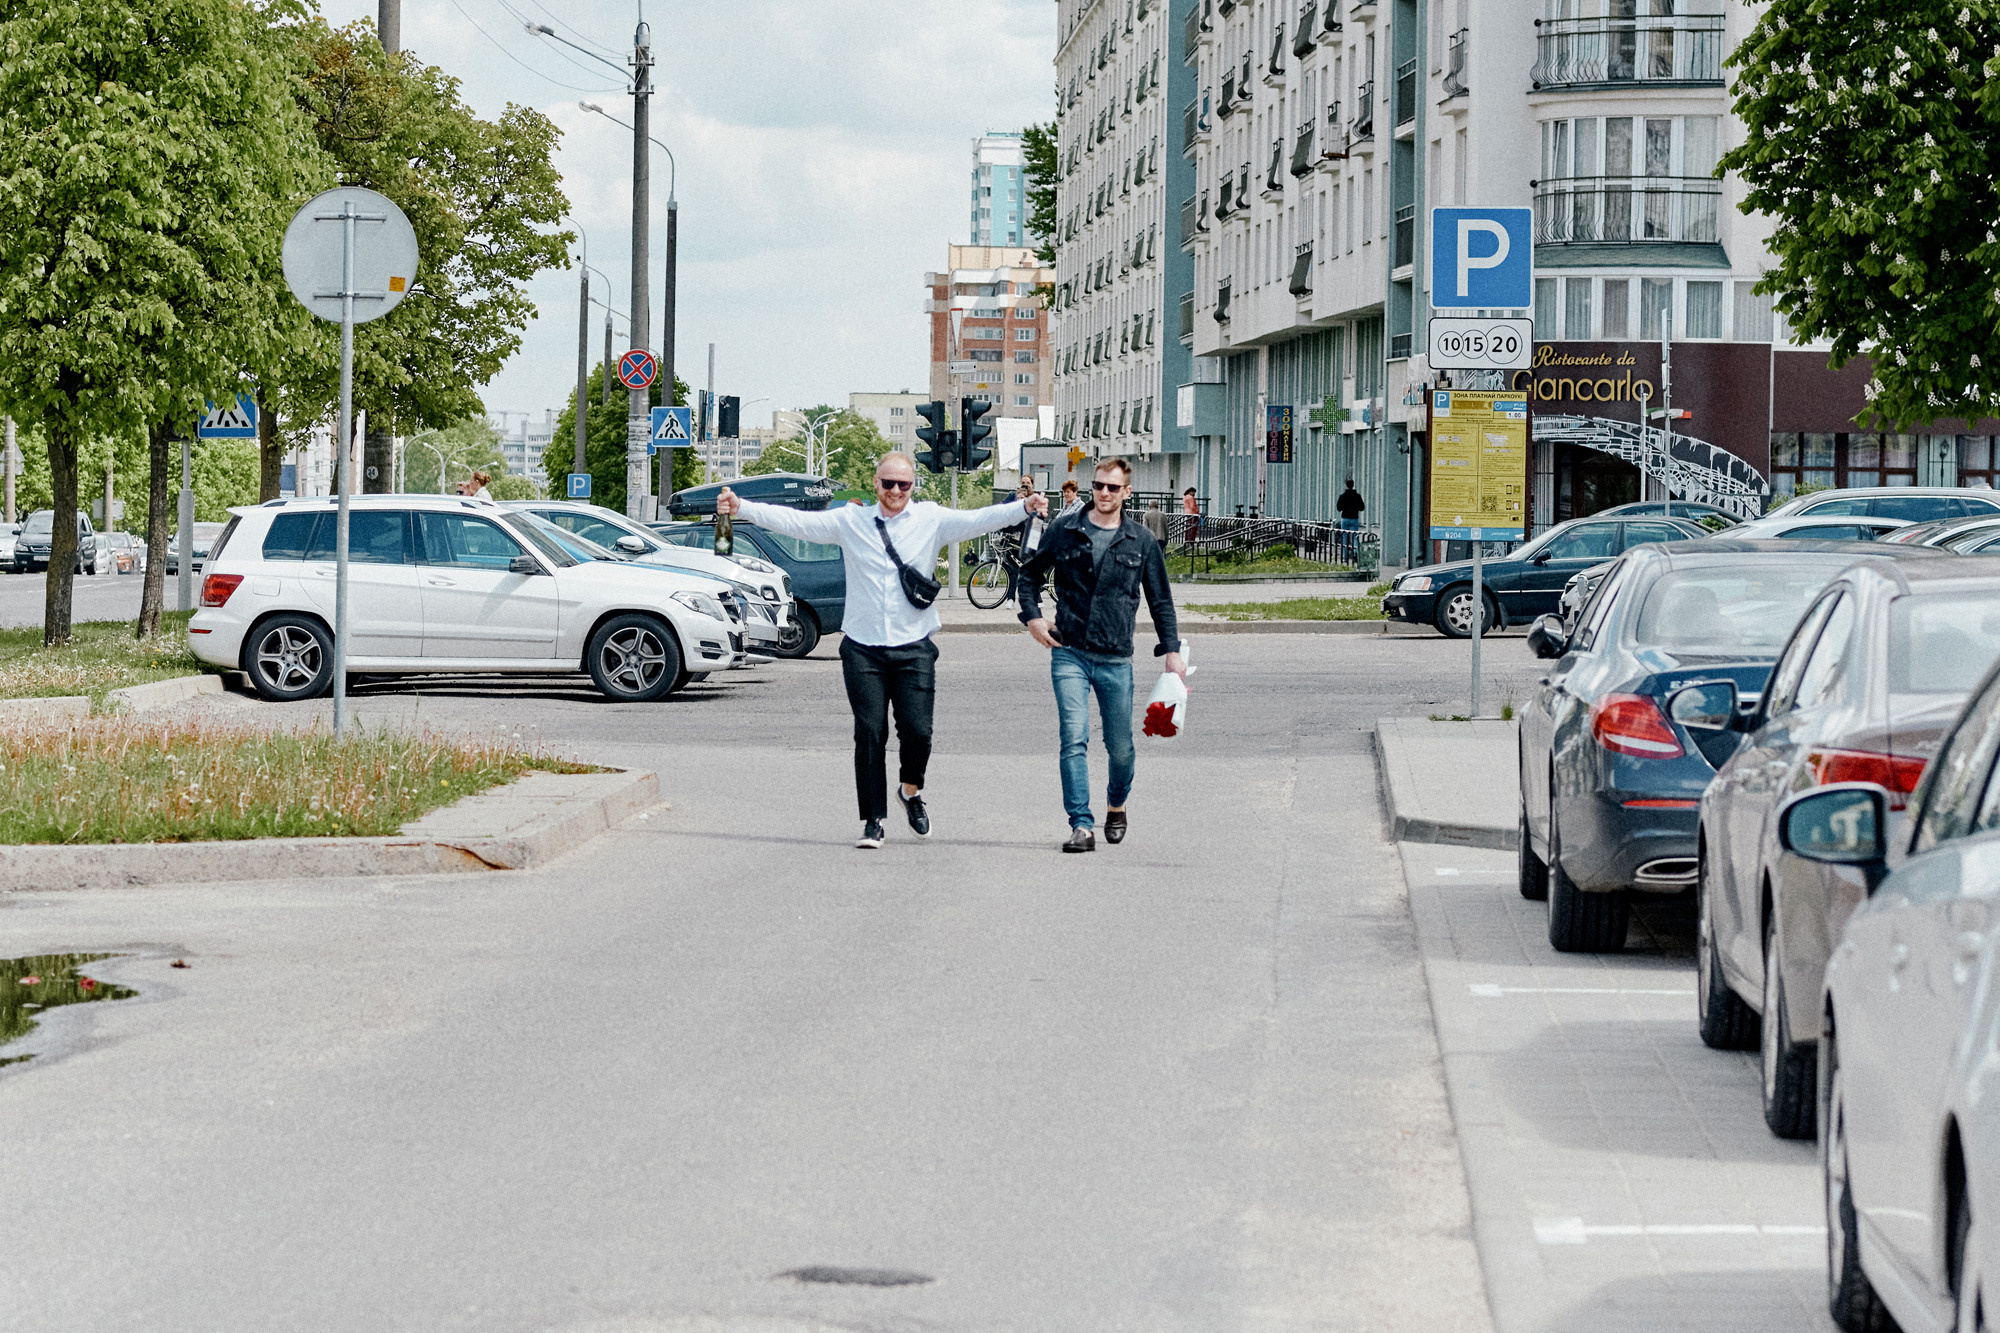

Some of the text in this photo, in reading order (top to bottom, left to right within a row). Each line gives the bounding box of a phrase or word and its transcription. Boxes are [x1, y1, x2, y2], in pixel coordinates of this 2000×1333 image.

[1456, 218, 1511, 297] P
[1443, 336, 1518, 353] 10 15 20
[1532, 345, 1637, 368] Ristorante da
[1511, 369, 1654, 402] Giancarlo
[1437, 393, 1447, 406] P
[573, 476, 586, 495] P
